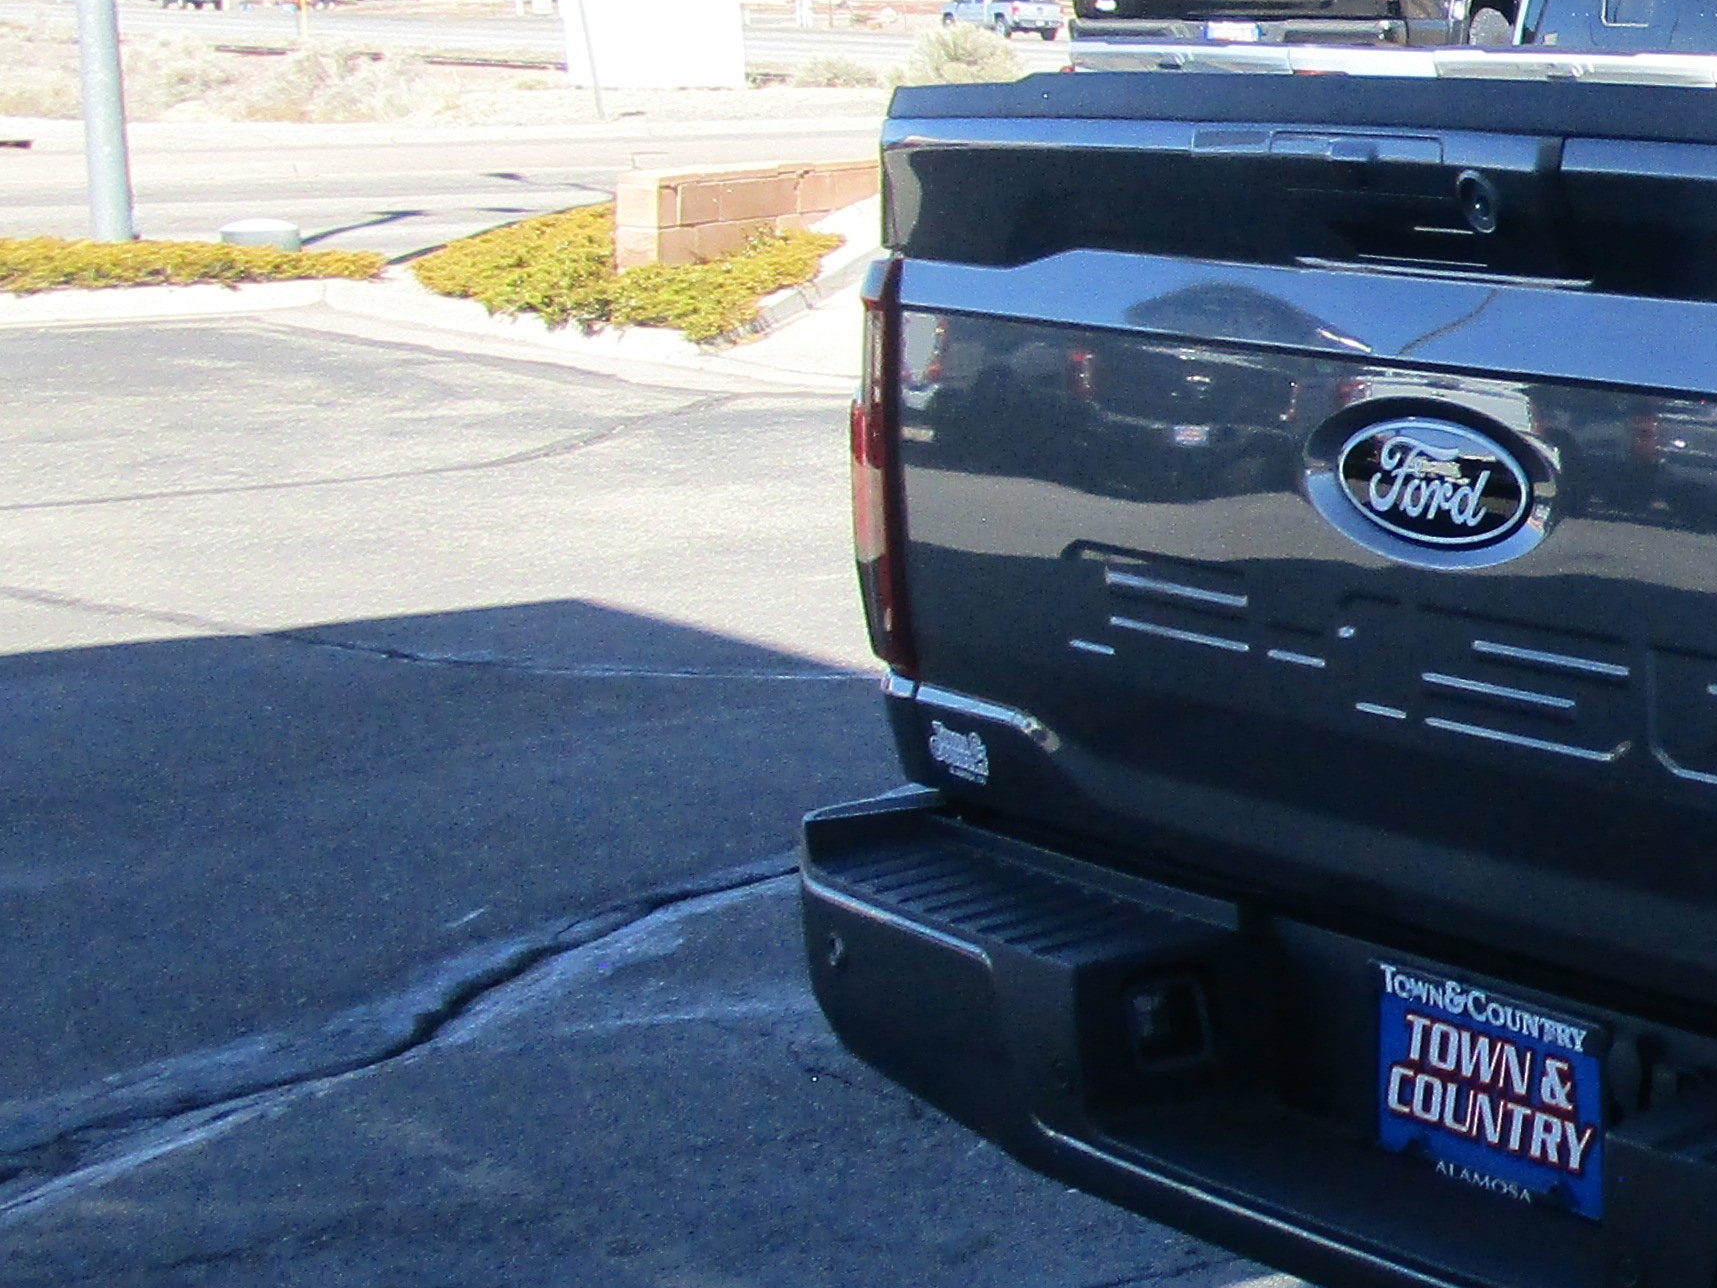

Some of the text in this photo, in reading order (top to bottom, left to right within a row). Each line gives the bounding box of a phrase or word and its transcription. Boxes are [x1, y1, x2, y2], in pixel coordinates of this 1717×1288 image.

[1369, 436, 1491, 527] Ford
[1405, 1014, 1574, 1111] TOWN &
[1387, 1065, 1593, 1170] COUNTRY
[1435, 1160, 1532, 1204] ALAMOSA
